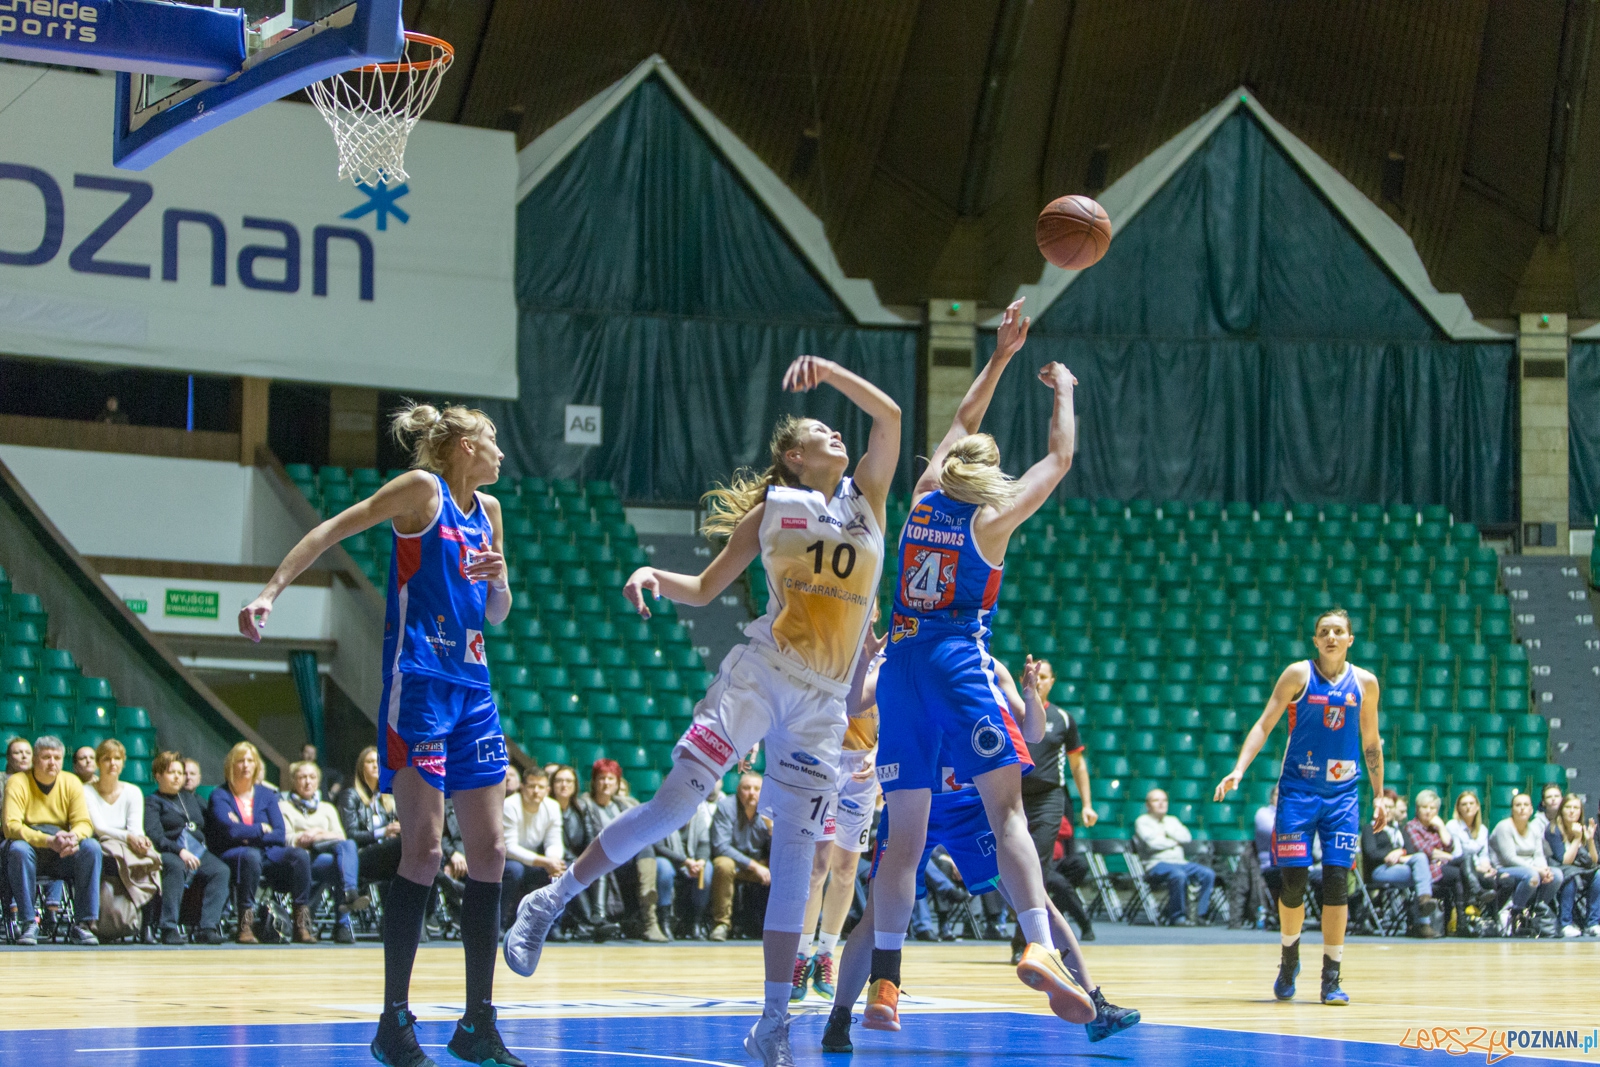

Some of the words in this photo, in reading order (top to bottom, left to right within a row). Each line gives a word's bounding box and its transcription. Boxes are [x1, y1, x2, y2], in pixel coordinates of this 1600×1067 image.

[570, 415, 597, 434] A6
[783, 518, 807, 526] TAURON
[819, 515, 843, 529] GEDO
[906, 524, 966, 547] KOPERWAS
[806, 540, 857, 580] 10
[906, 550, 943, 610] 4
[169, 593, 215, 605] WYJŚCIE
[1329, 706, 1341, 729] 7
[695, 726, 732, 759] TAURON
[1558, 742, 1569, 753] 7
[801, 766, 828, 780] Motors
[876, 764, 899, 775] TIS
[859, 829, 869, 845] 6
